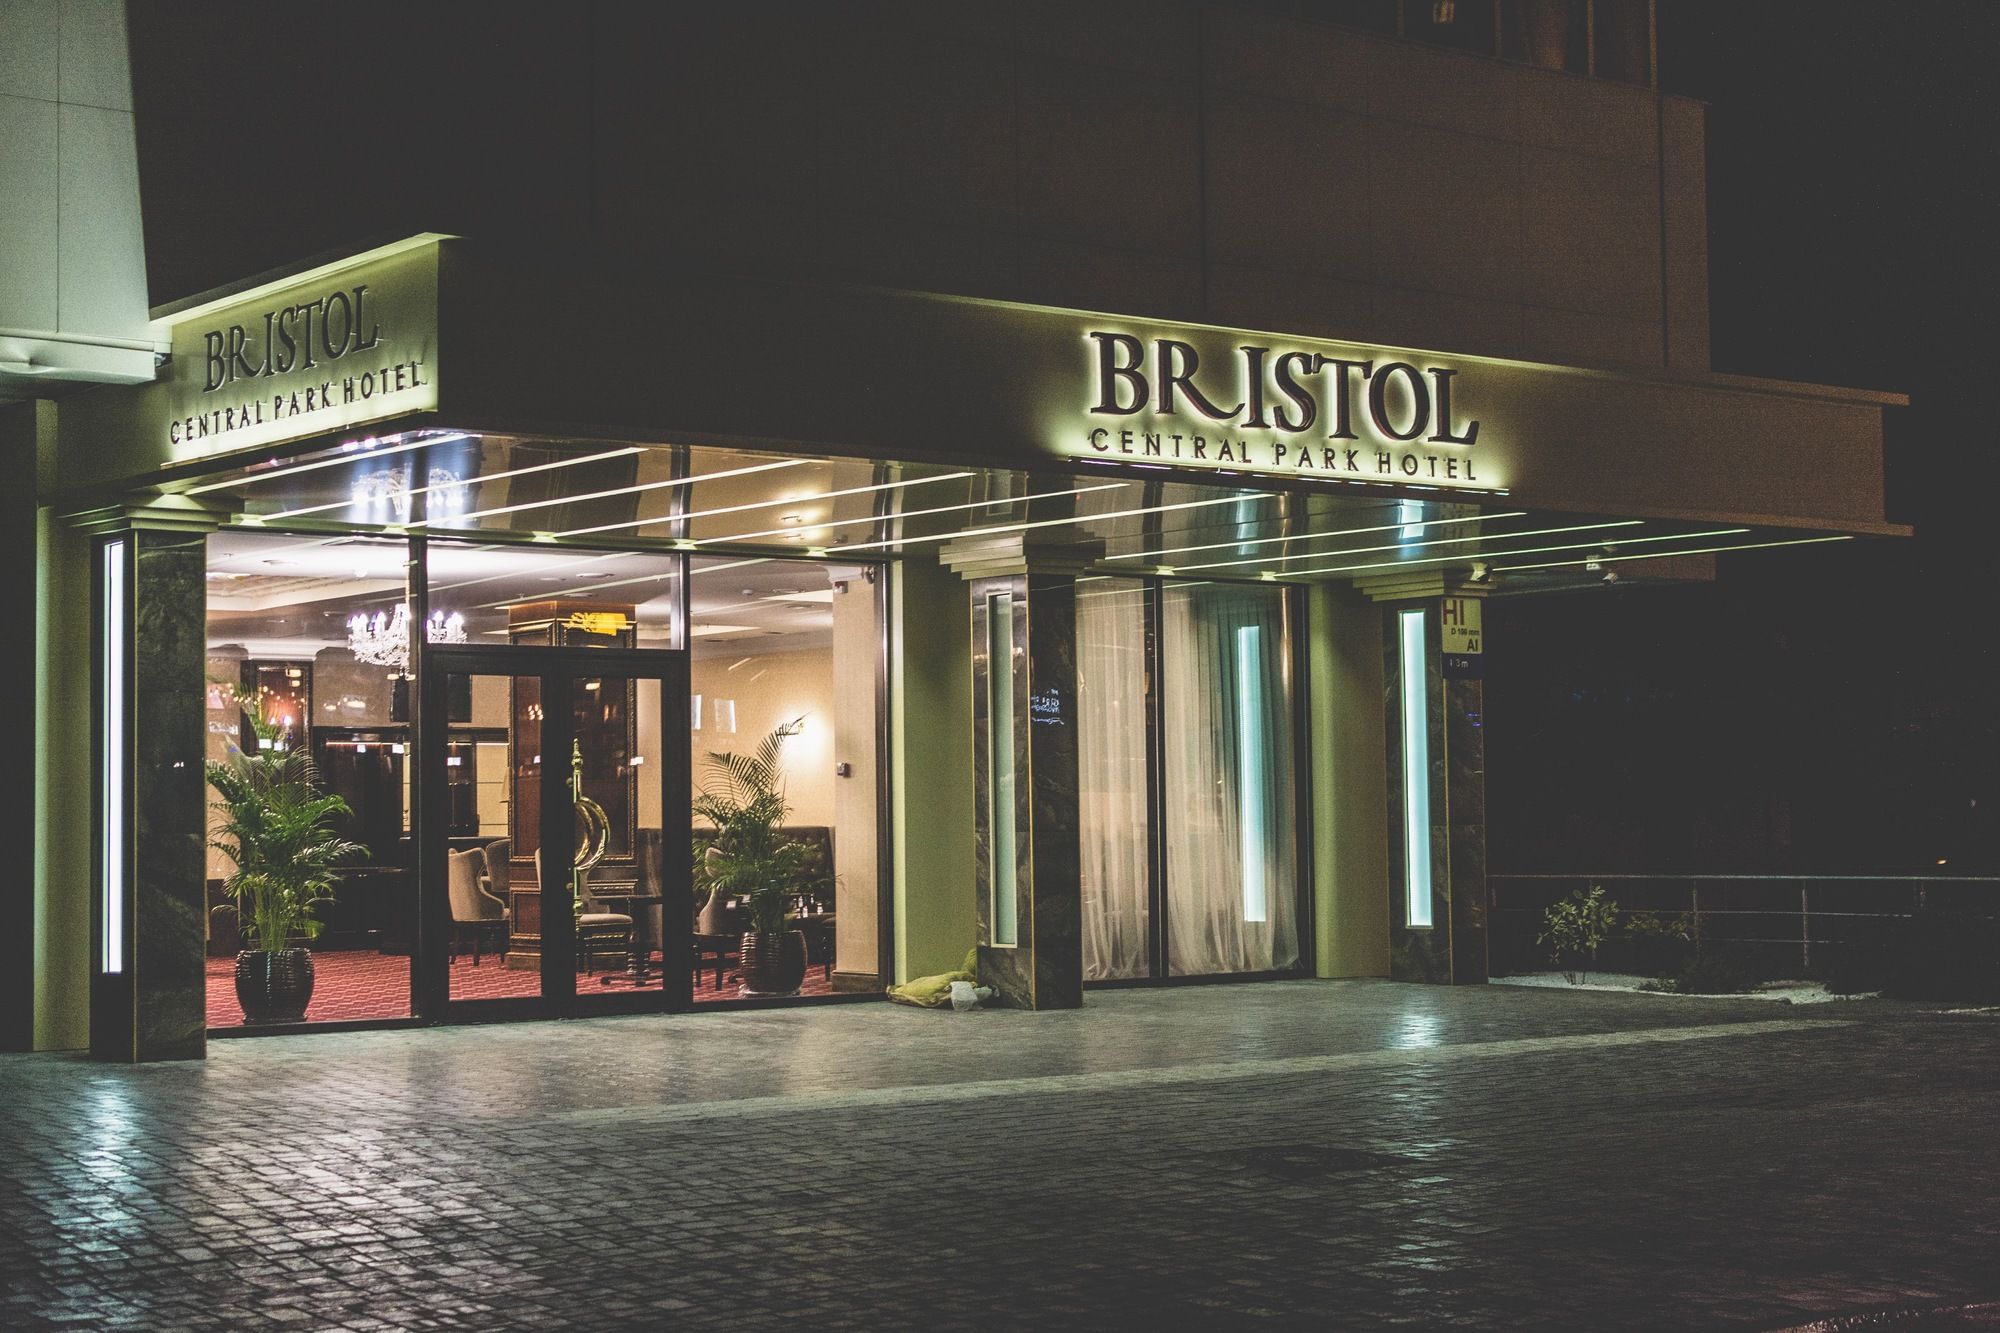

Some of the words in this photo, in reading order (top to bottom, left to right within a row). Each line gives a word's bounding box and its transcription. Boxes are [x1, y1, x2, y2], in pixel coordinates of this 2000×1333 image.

[203, 285, 380, 393] BRISTOL
[170, 399, 264, 445] CENTRAL
[274, 381, 331, 420] PARK
[343, 361, 421, 405] HOTEL
[1089, 331, 1480, 445] BRISTOL
[1091, 427, 1252, 465] CENTRAL
[1274, 442, 1360, 473] PARK
[1378, 452, 1478, 482] HOTEL
[1443, 600, 1464, 625] HI
